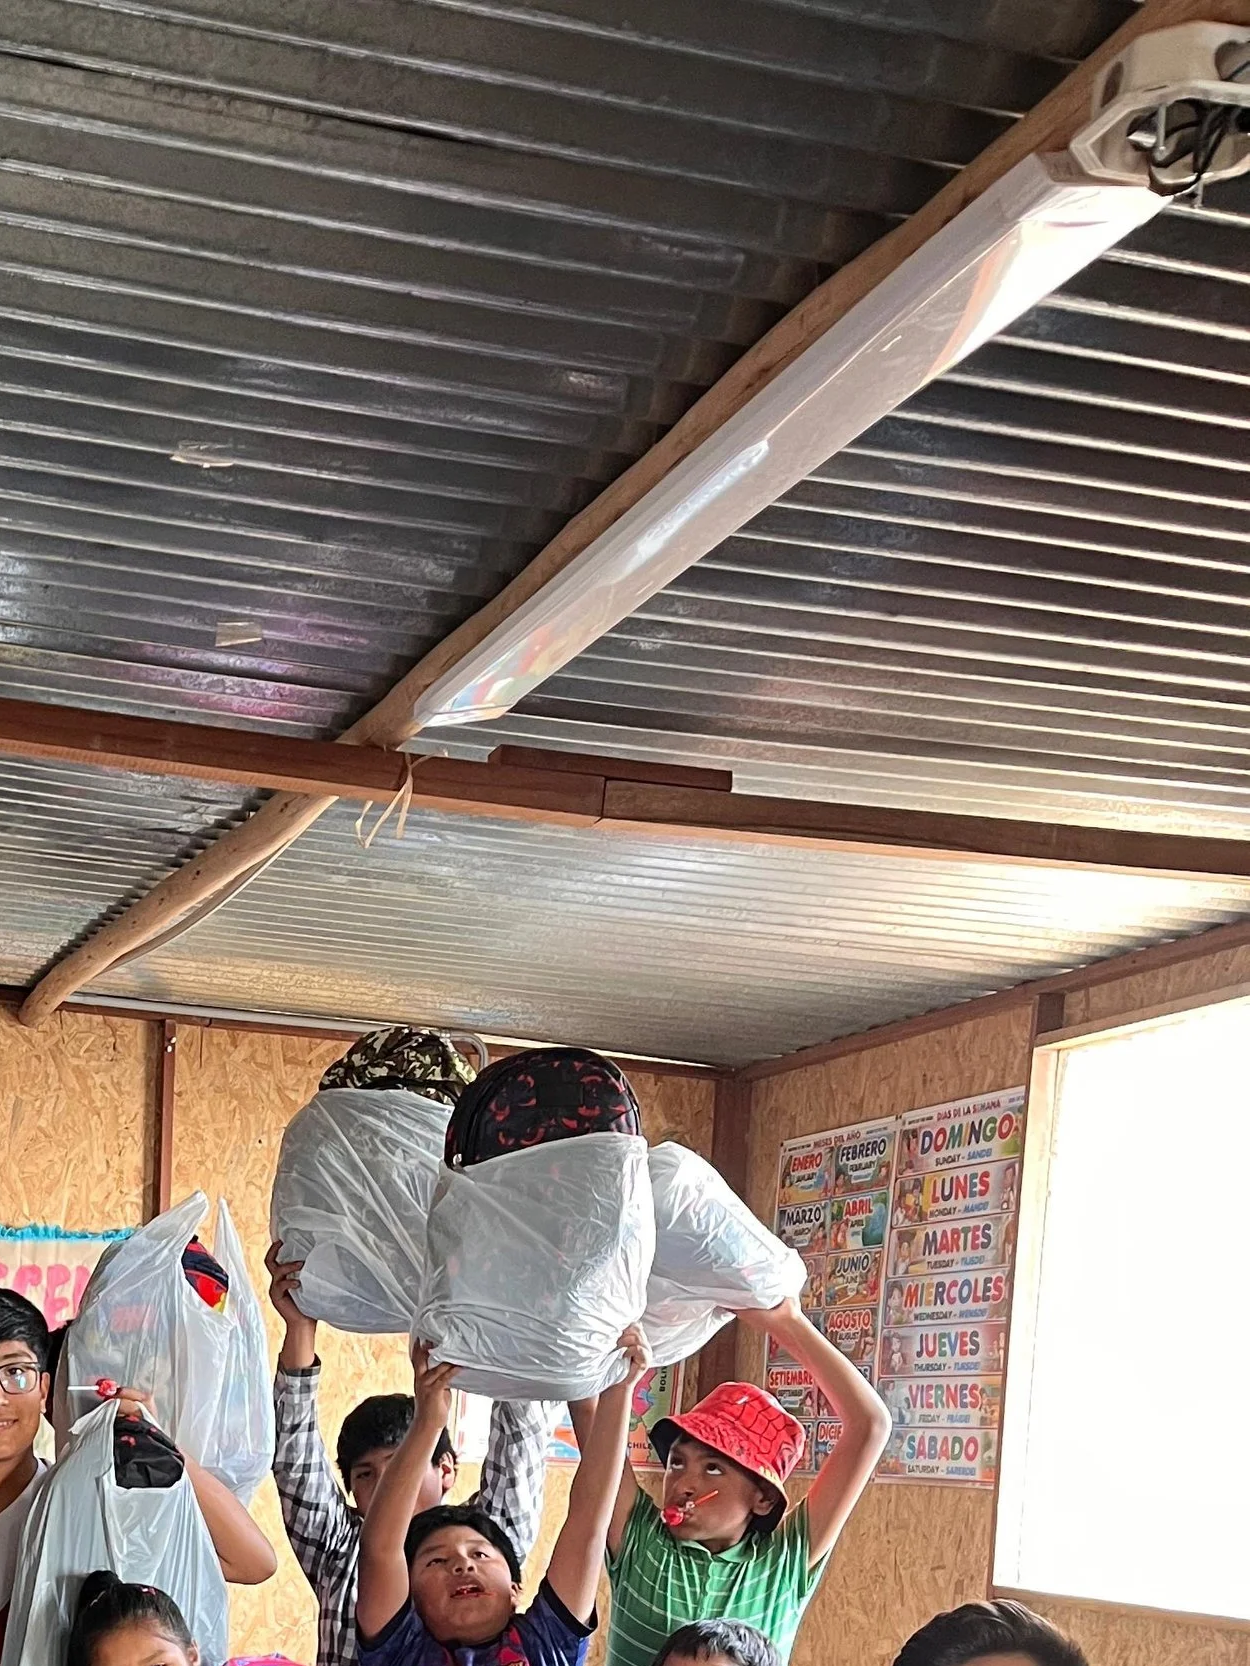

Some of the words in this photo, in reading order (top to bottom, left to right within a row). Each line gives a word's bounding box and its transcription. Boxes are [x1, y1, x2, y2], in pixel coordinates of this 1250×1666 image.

[920, 1113, 1014, 1155] DOMINGO
[840, 1138, 887, 1162] FEBRERO
[792, 1152, 823, 1172] ENERO
[935, 1154, 960, 1167] SUNDAY
[931, 1171, 990, 1203] LUNES
[786, 1207, 821, 1226] MARZO
[844, 1198, 873, 1217] ABRIL
[929, 1206, 957, 1218] MONDAY
[922, 1223, 991, 1256] MARTES
[837, 1254, 870, 1273] JUNIO
[927, 1259, 954, 1269] TUESDAY
[829, 1310, 870, 1330] AGOSTO
[913, 1310, 952, 1320] WEDNESDAY
[916, 1330, 980, 1358] JUEVES
[914, 1363, 946, 1372] THURSDAY
[770, 1369, 813, 1386] SETIEMBRE
[908, 1383, 981, 1409] VIERNES
[918, 1415, 940, 1424] FRIDAY
[906, 1431, 979, 1461] SÁBADO
[907, 1465, 939, 1474] SATURDAY
